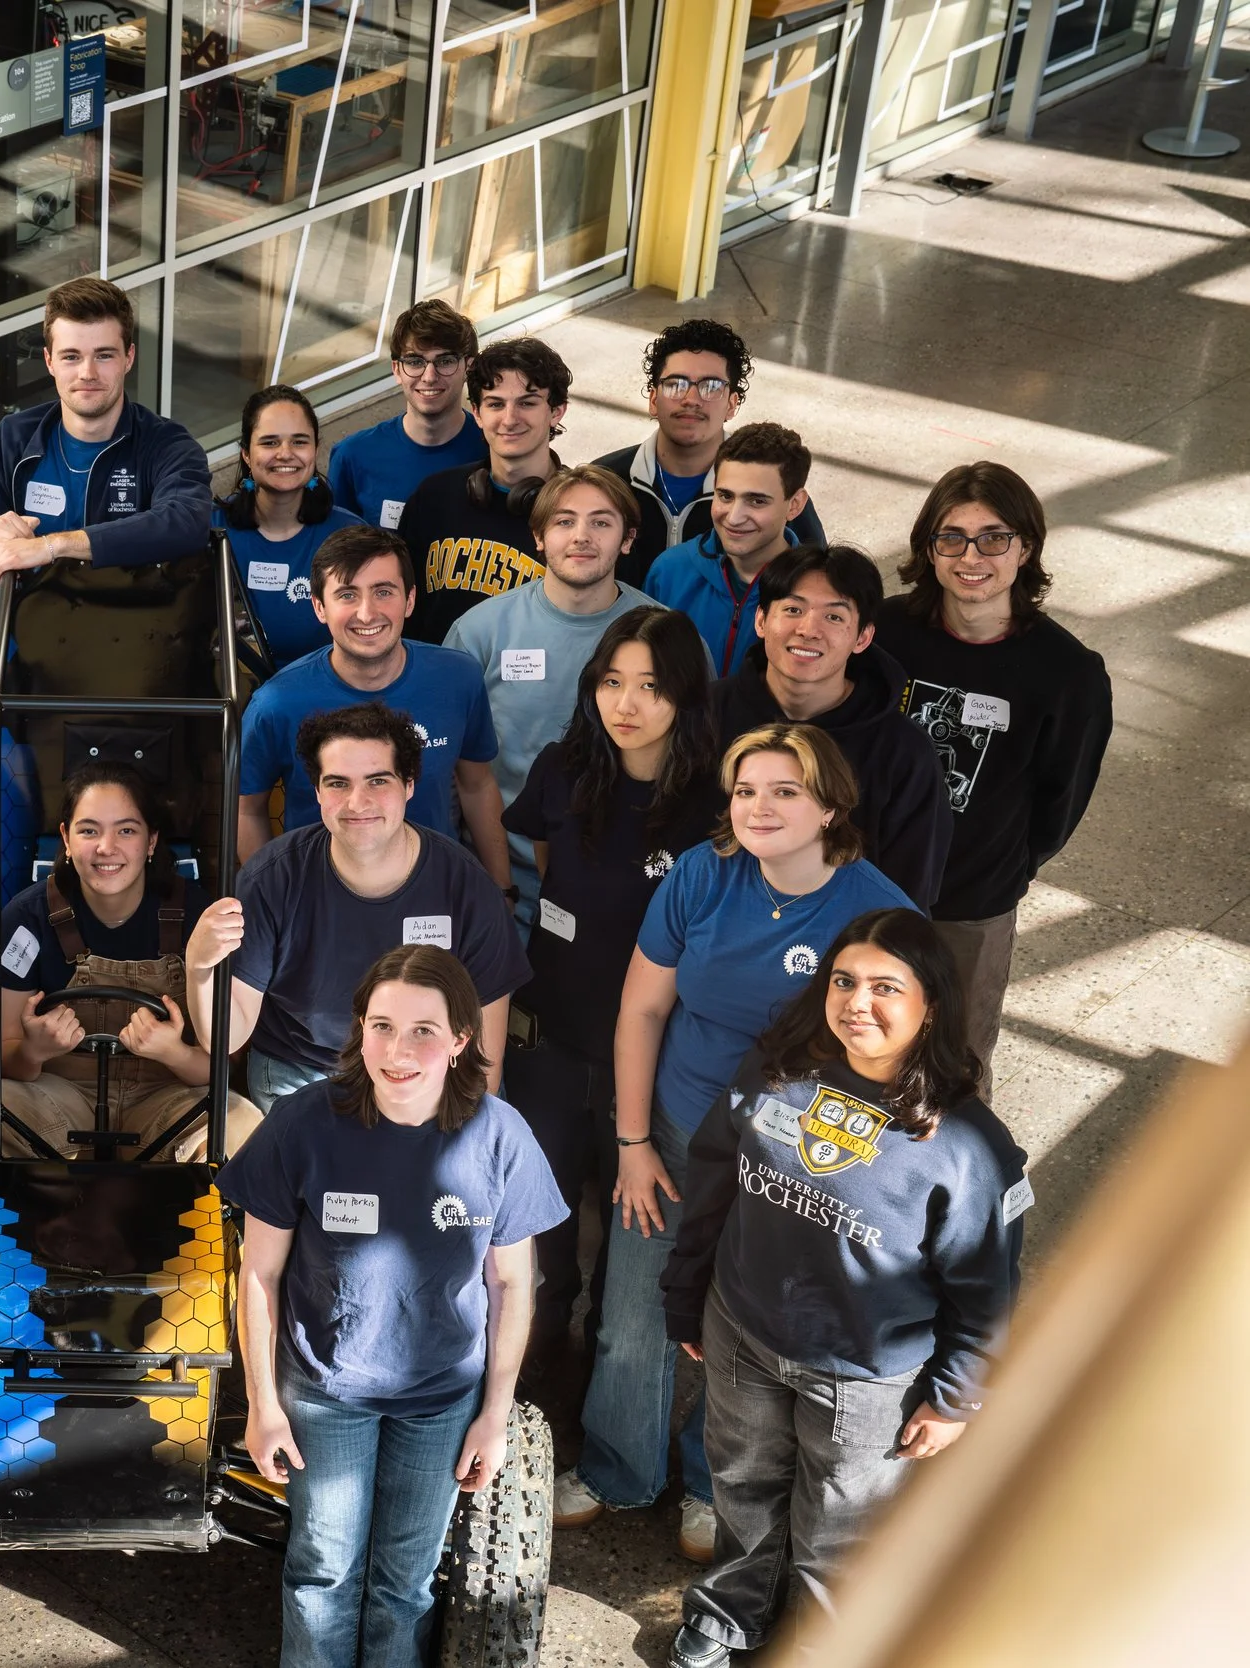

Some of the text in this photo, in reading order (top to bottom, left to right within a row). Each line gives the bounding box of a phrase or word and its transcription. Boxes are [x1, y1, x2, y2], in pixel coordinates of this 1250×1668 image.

[74, 14, 109, 33] NICE
[70, 48, 103, 62] Fabrication
[14, 67, 25, 76] 104
[70, 62, 86, 73] Shop
[426, 537, 548, 596] ROCHEST
[294, 585, 307, 593] UR
[970, 699, 998, 713] Gabe
[432, 736, 448, 747] SAE
[653, 867, 665, 877] BA
[412, 921, 437, 930] Aidan
[794, 954, 808, 966] UR
[844, 1097, 864, 1112] 1850
[773, 1109, 796, 1124] Elisa
[758, 1163, 864, 1219] UNIVERSITY of
[326, 1195, 348, 1207] Ruby
[738, 1153, 883, 1248] ROCHESTER
[443, 1207, 458, 1217] UR
[446, 1216, 493, 1226] BAJA SAE
